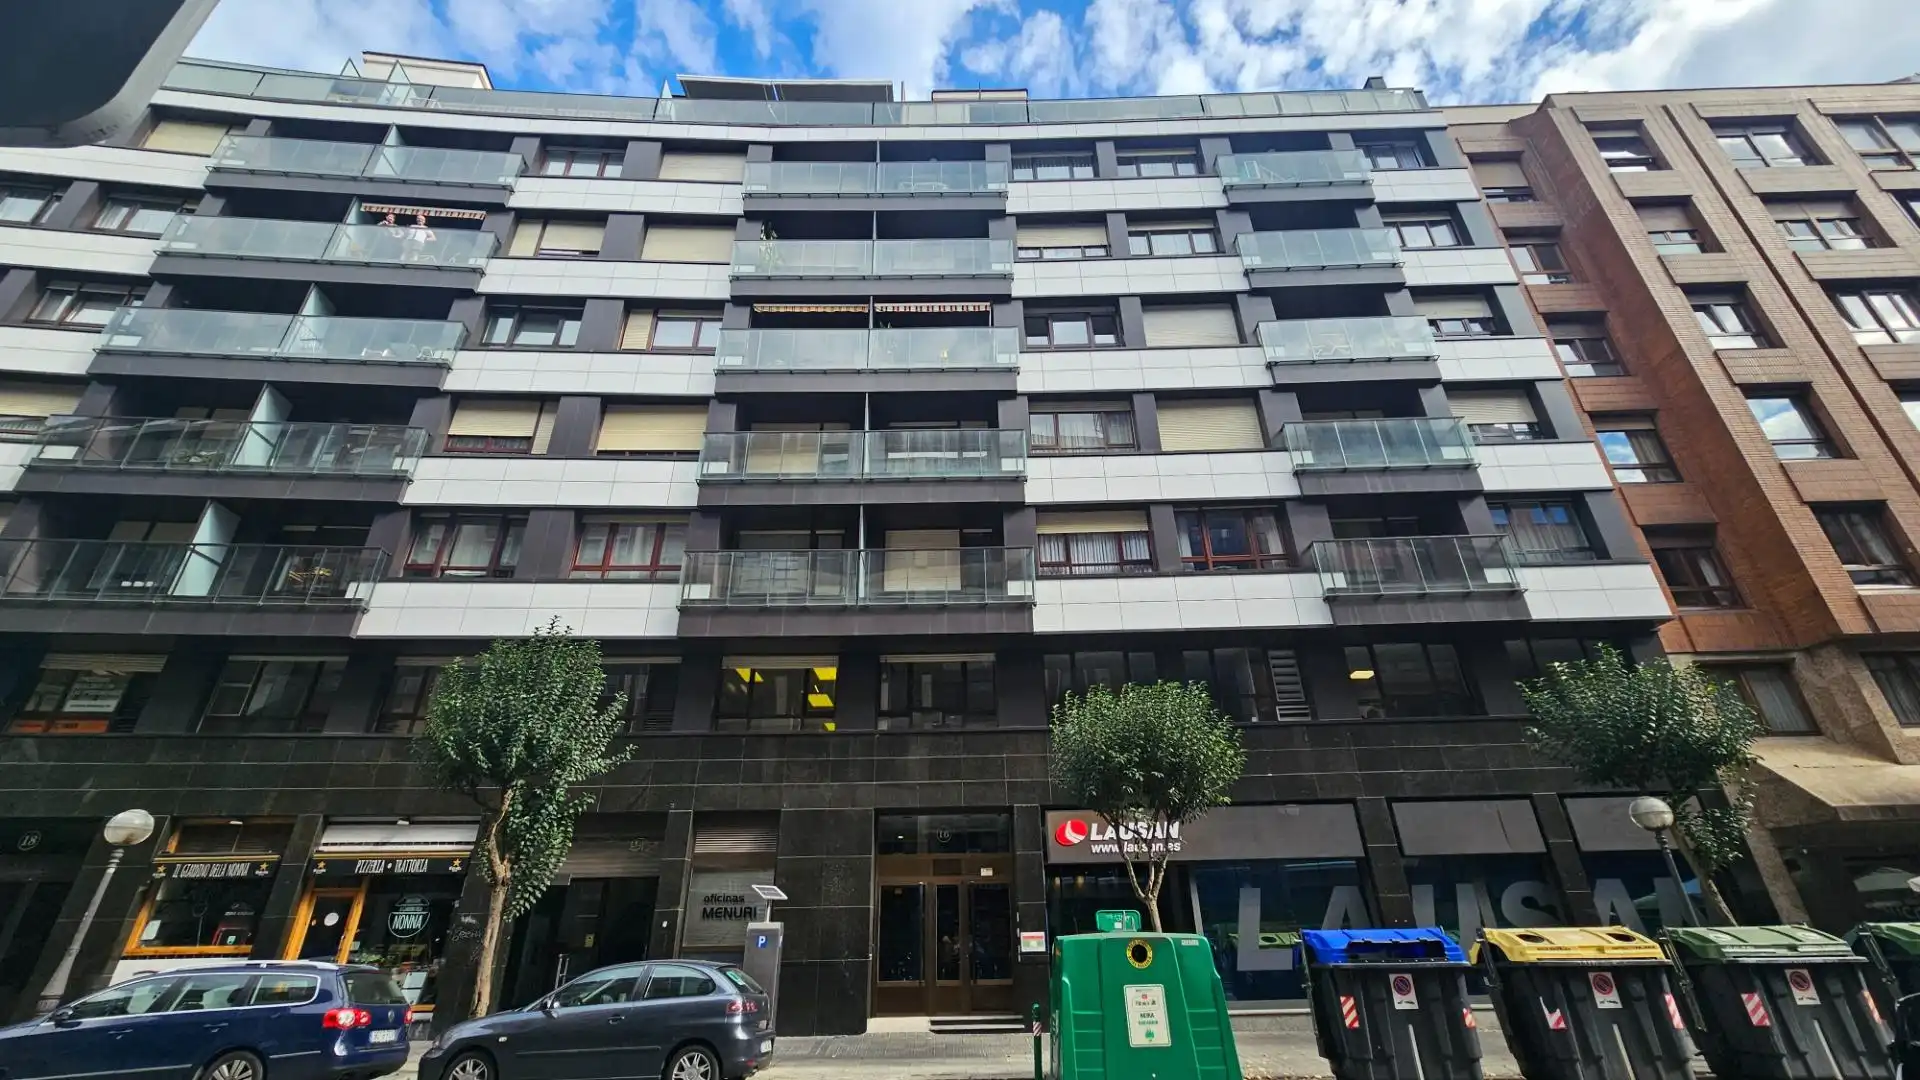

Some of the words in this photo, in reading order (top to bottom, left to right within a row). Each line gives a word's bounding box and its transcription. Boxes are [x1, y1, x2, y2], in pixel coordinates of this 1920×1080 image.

[1090, 821, 1180, 841] LAUSAN
[354, 859, 385, 874] PIZZERIA
[394, 858, 429, 873] TRATTORIA
[703, 893, 745, 905] oficinas
[702, 906, 757, 920] MENURI
[392, 914, 424, 930] NONNA
[758, 936, 766, 948] P
